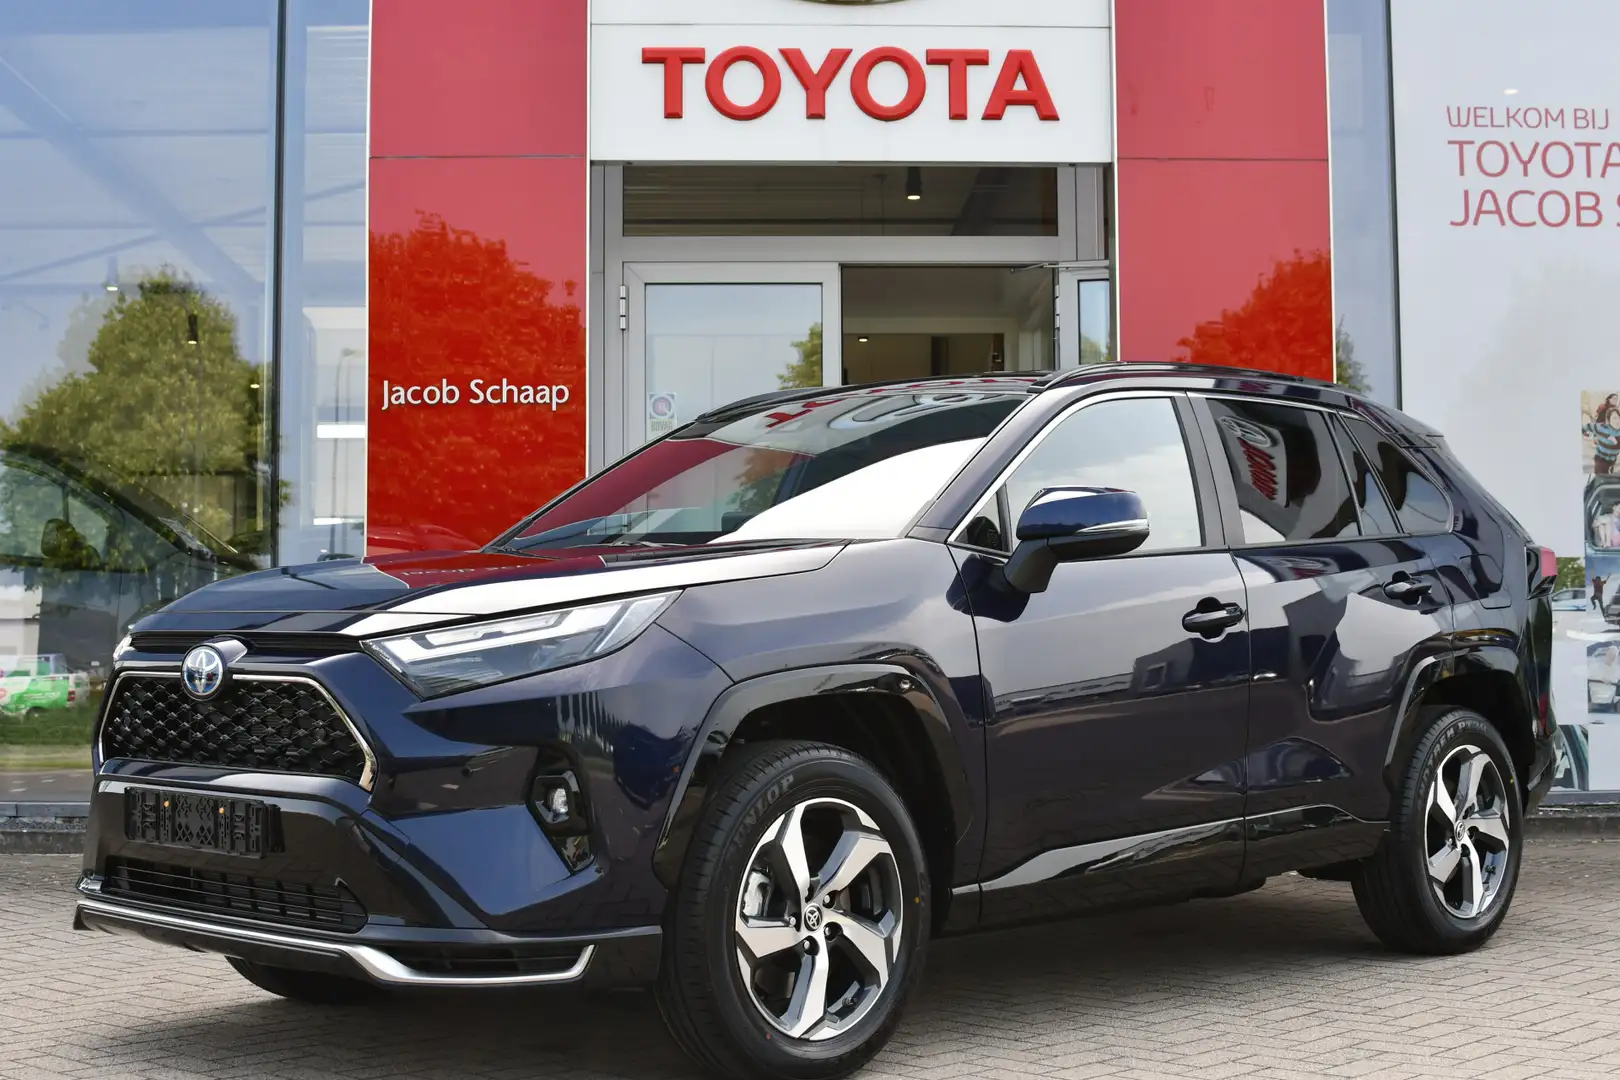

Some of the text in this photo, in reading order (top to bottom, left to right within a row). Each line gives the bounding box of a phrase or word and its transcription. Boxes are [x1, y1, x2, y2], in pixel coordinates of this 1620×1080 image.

[642, 46, 1060, 121] TOYOTA
[1447, 106, 1609, 130] WELKOM BIJ
[1447, 140, 1620, 179] TOYOTA
[1449, 189, 1603, 228] JACOB
[381, 378, 570, 411] Jacob Schaap
[728, 774, 795, 855] UNLOP
